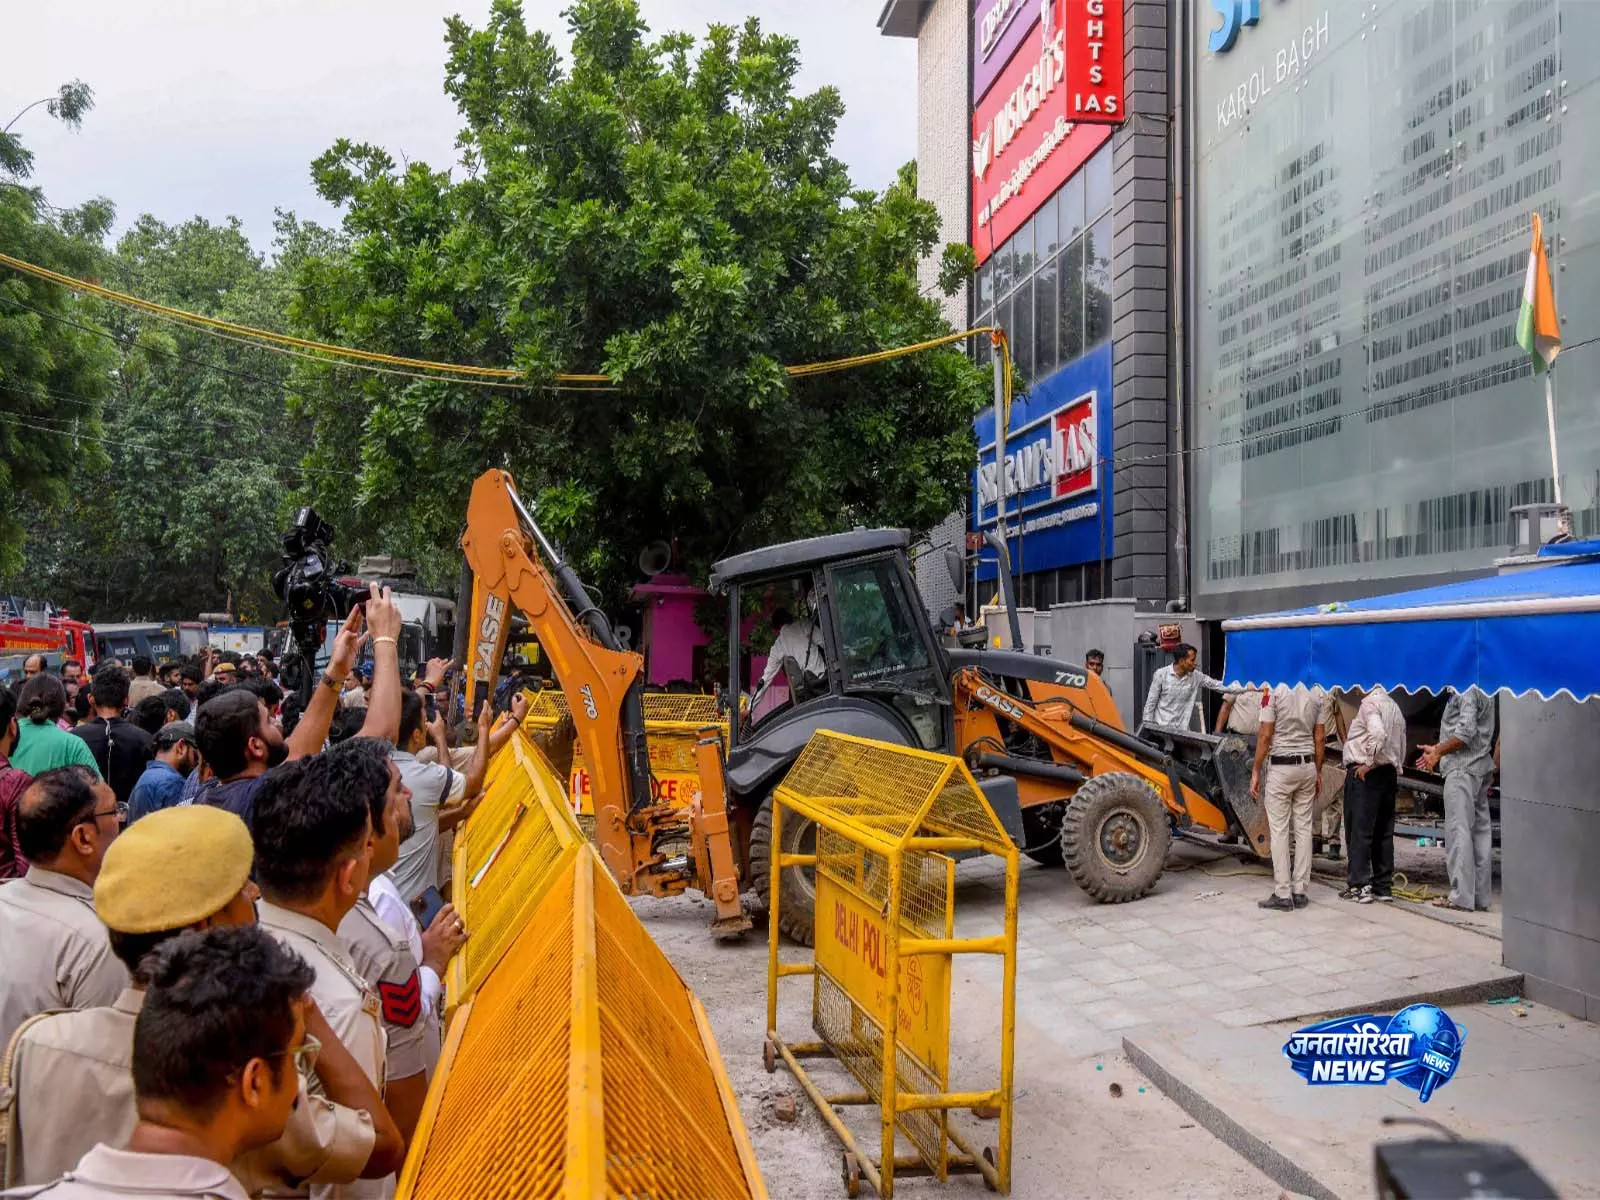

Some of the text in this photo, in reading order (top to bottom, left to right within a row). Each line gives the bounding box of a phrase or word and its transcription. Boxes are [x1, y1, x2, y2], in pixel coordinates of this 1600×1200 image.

[1217, 65, 1271, 132] KAROL
[1276, 11, 1328, 83] BAGH
[1075, 94, 1117, 114] IAS
[1056, 416, 1094, 478] IAS
[474, 592, 505, 681] CASE
[580, 684, 598, 719] 770
[976, 686, 1024, 719] CASE
[1055, 672, 1086, 687] 770
[834, 900, 859, 957] DELHI
